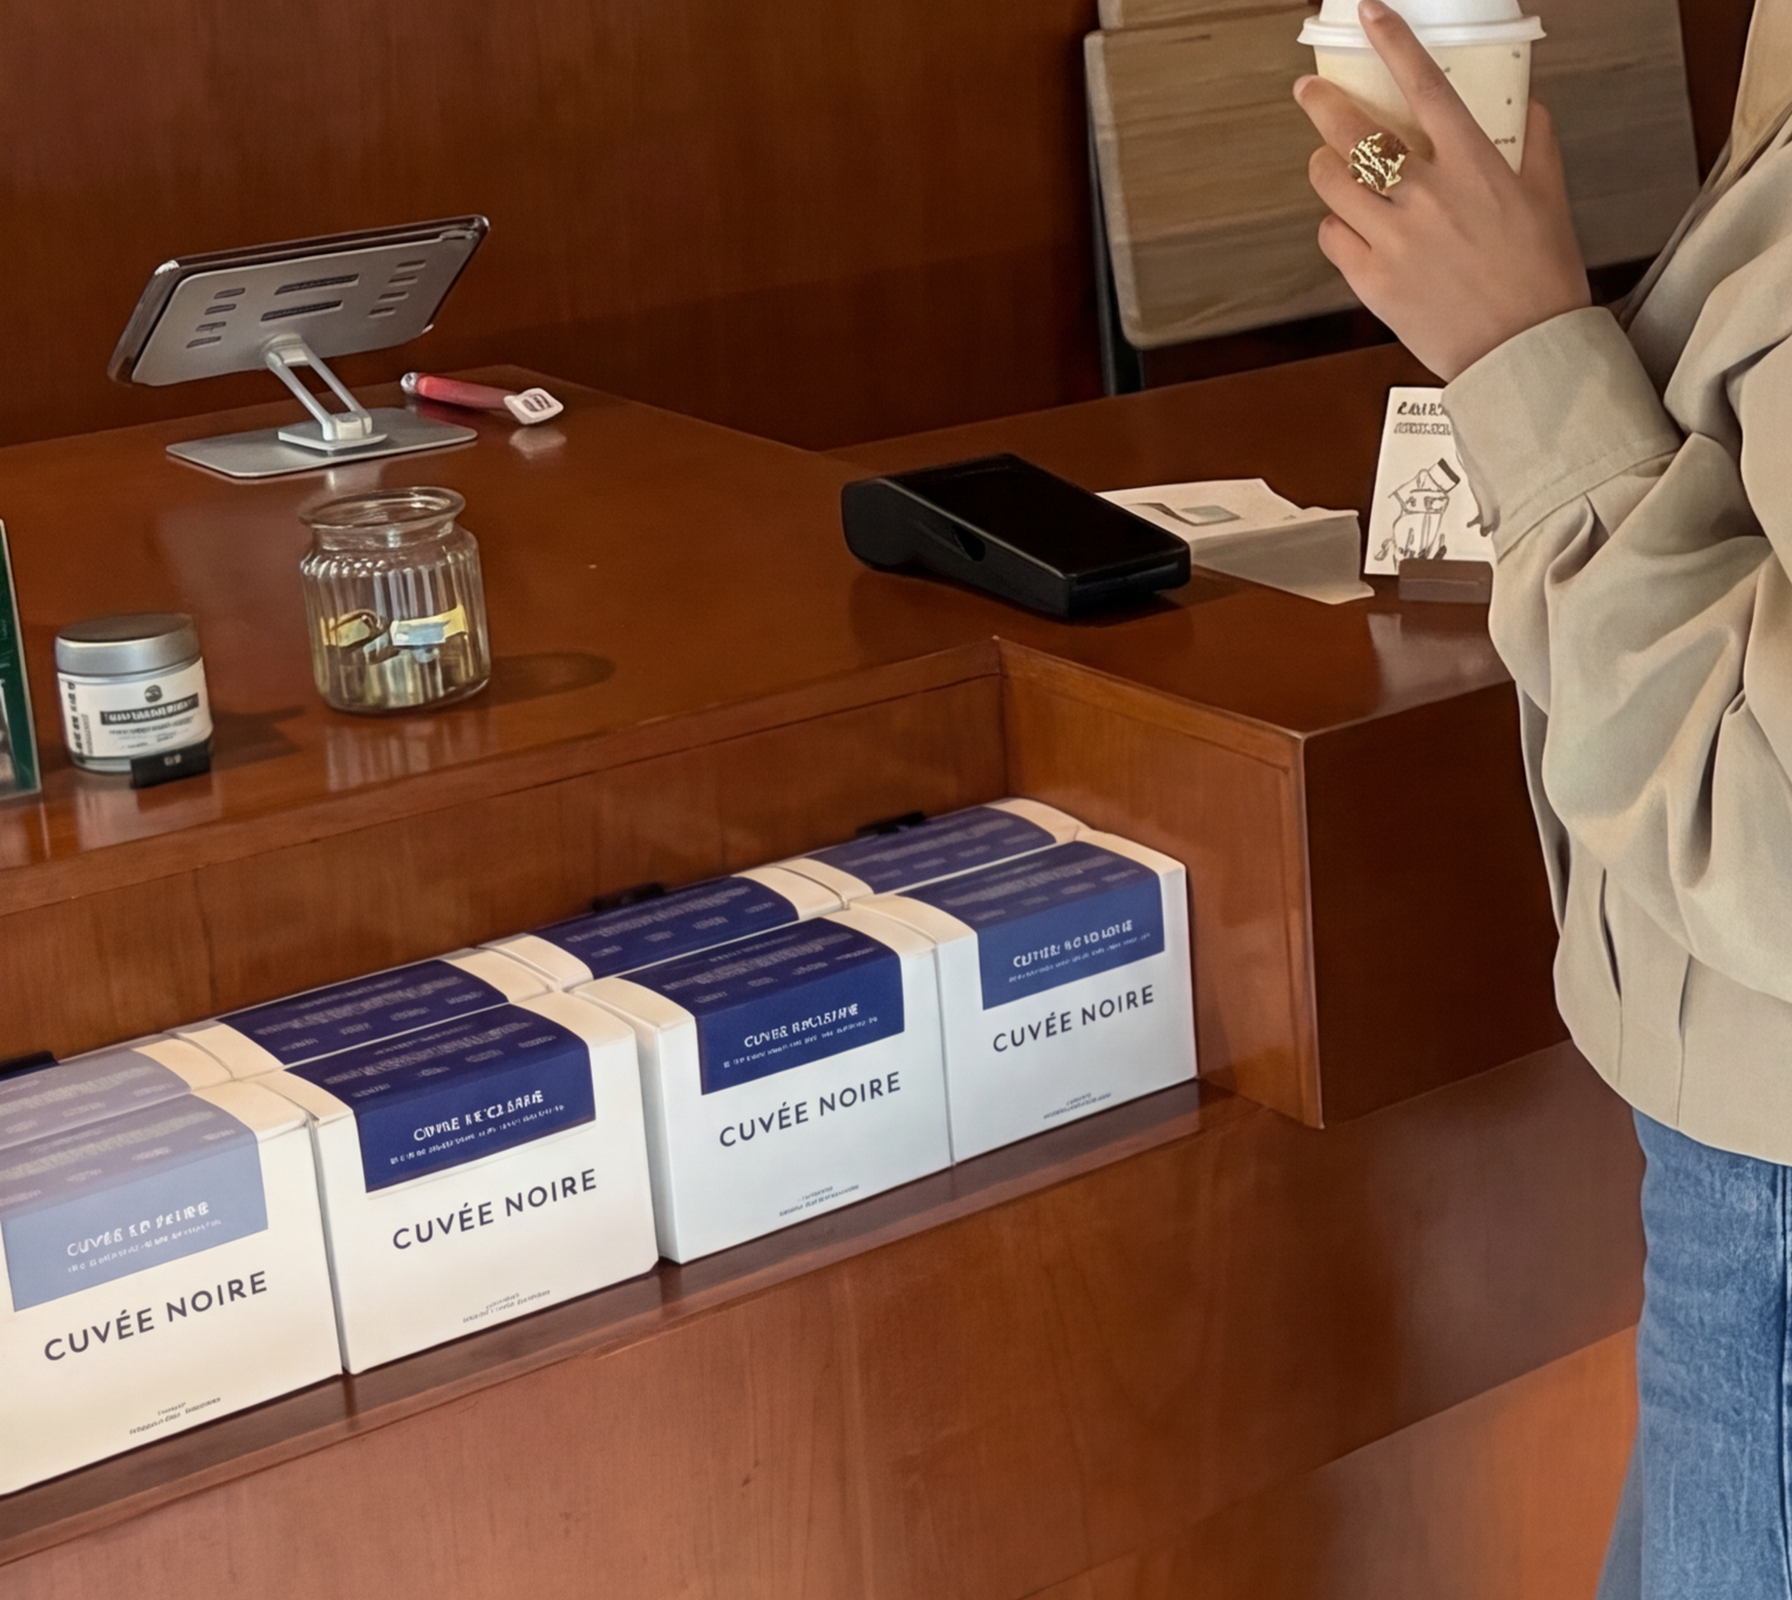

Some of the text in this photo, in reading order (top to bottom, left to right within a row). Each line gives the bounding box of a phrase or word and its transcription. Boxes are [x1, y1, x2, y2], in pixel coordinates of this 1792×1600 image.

[993, 984, 1154, 1053] CUVÉE NOIRE
[719, 1071, 901, 1147] CUVÉE NOIRE
[393, 1168, 597, 1250] CUVÉE NOIRE
[44, 1270, 268, 1361] CUVÉE NOIRE
